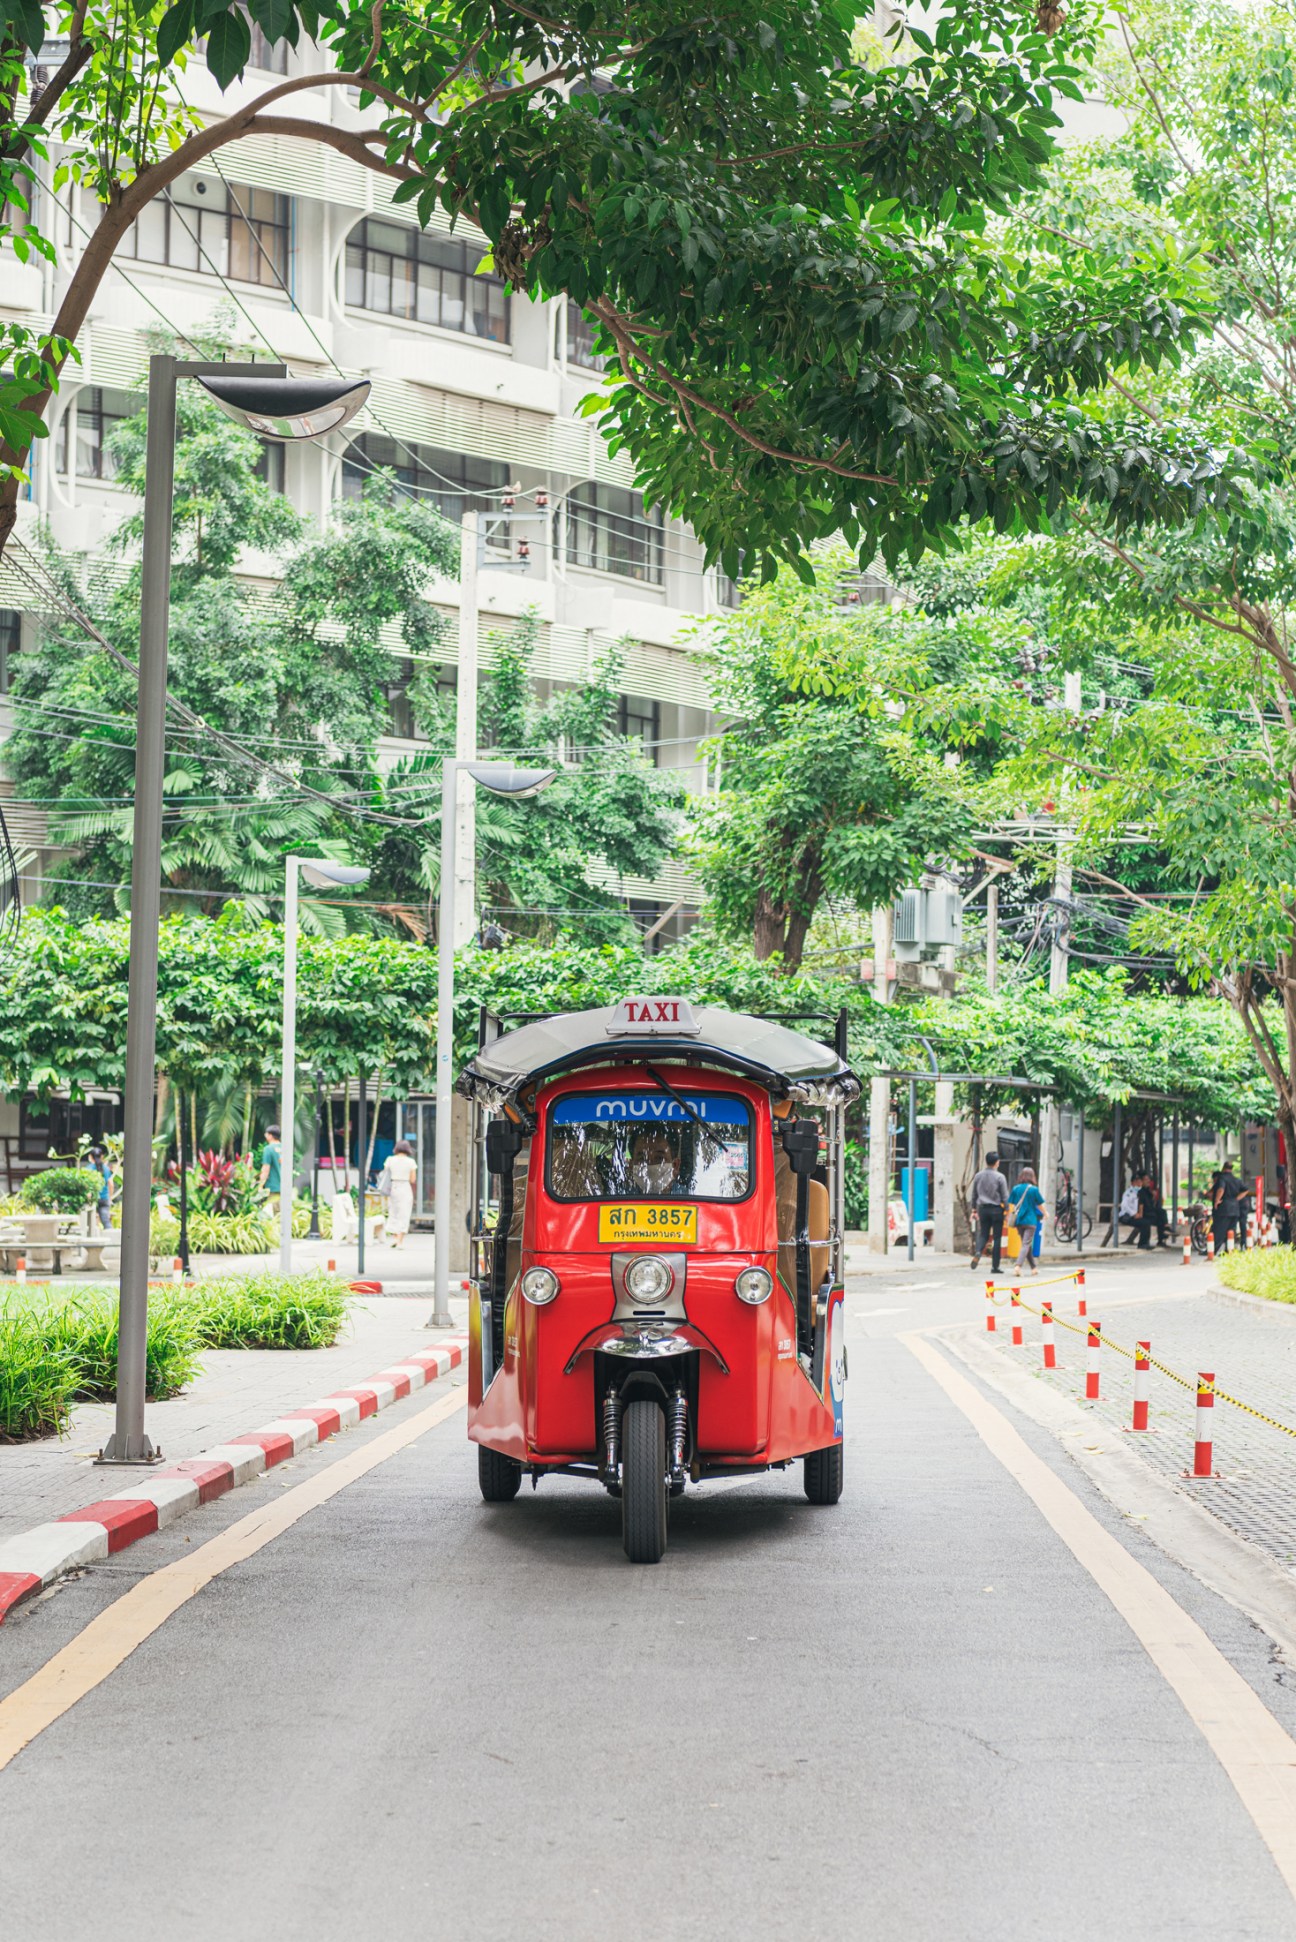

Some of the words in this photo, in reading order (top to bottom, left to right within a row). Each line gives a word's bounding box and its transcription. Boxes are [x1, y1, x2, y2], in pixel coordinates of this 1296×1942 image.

[623, 1002, 680, 1022] TAXI
[609, 1207, 637, 1225] สก
[647, 1208, 693, 1226] 3857
[613, 1229, 682, 1240] กรุงเทพมหานคร
